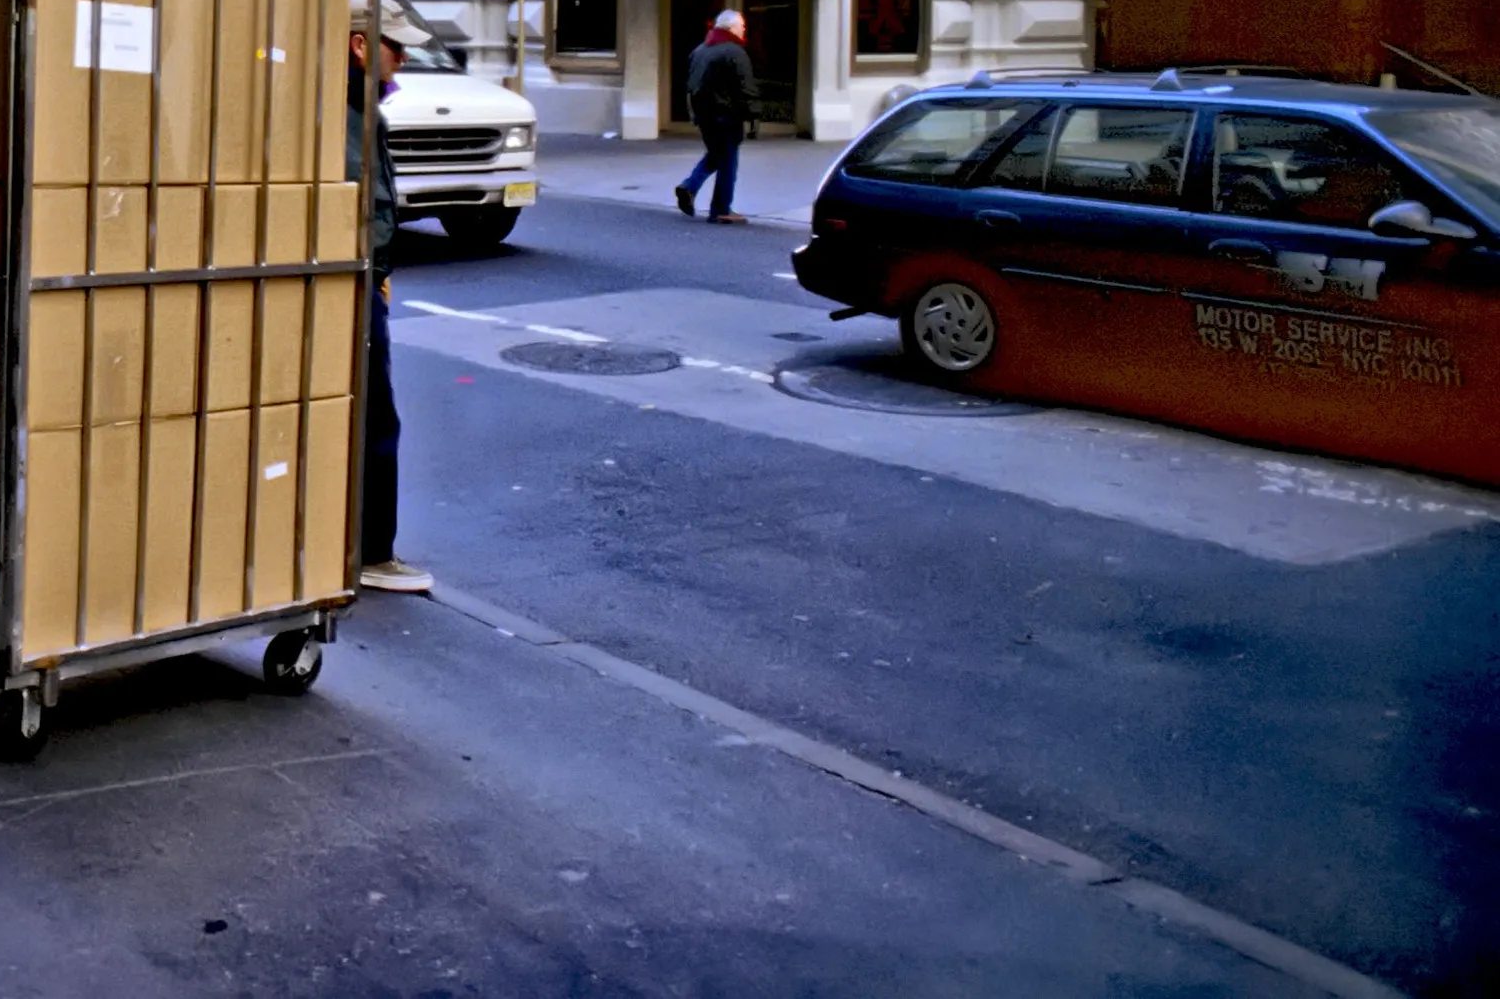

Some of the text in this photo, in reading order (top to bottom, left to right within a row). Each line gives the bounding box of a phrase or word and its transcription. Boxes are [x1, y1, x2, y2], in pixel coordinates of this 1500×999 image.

[1196, 304, 1276, 335] MOTOR
[1287, 319, 1395, 354] SERVICE
[1342, 349, 1388, 377] NYC
